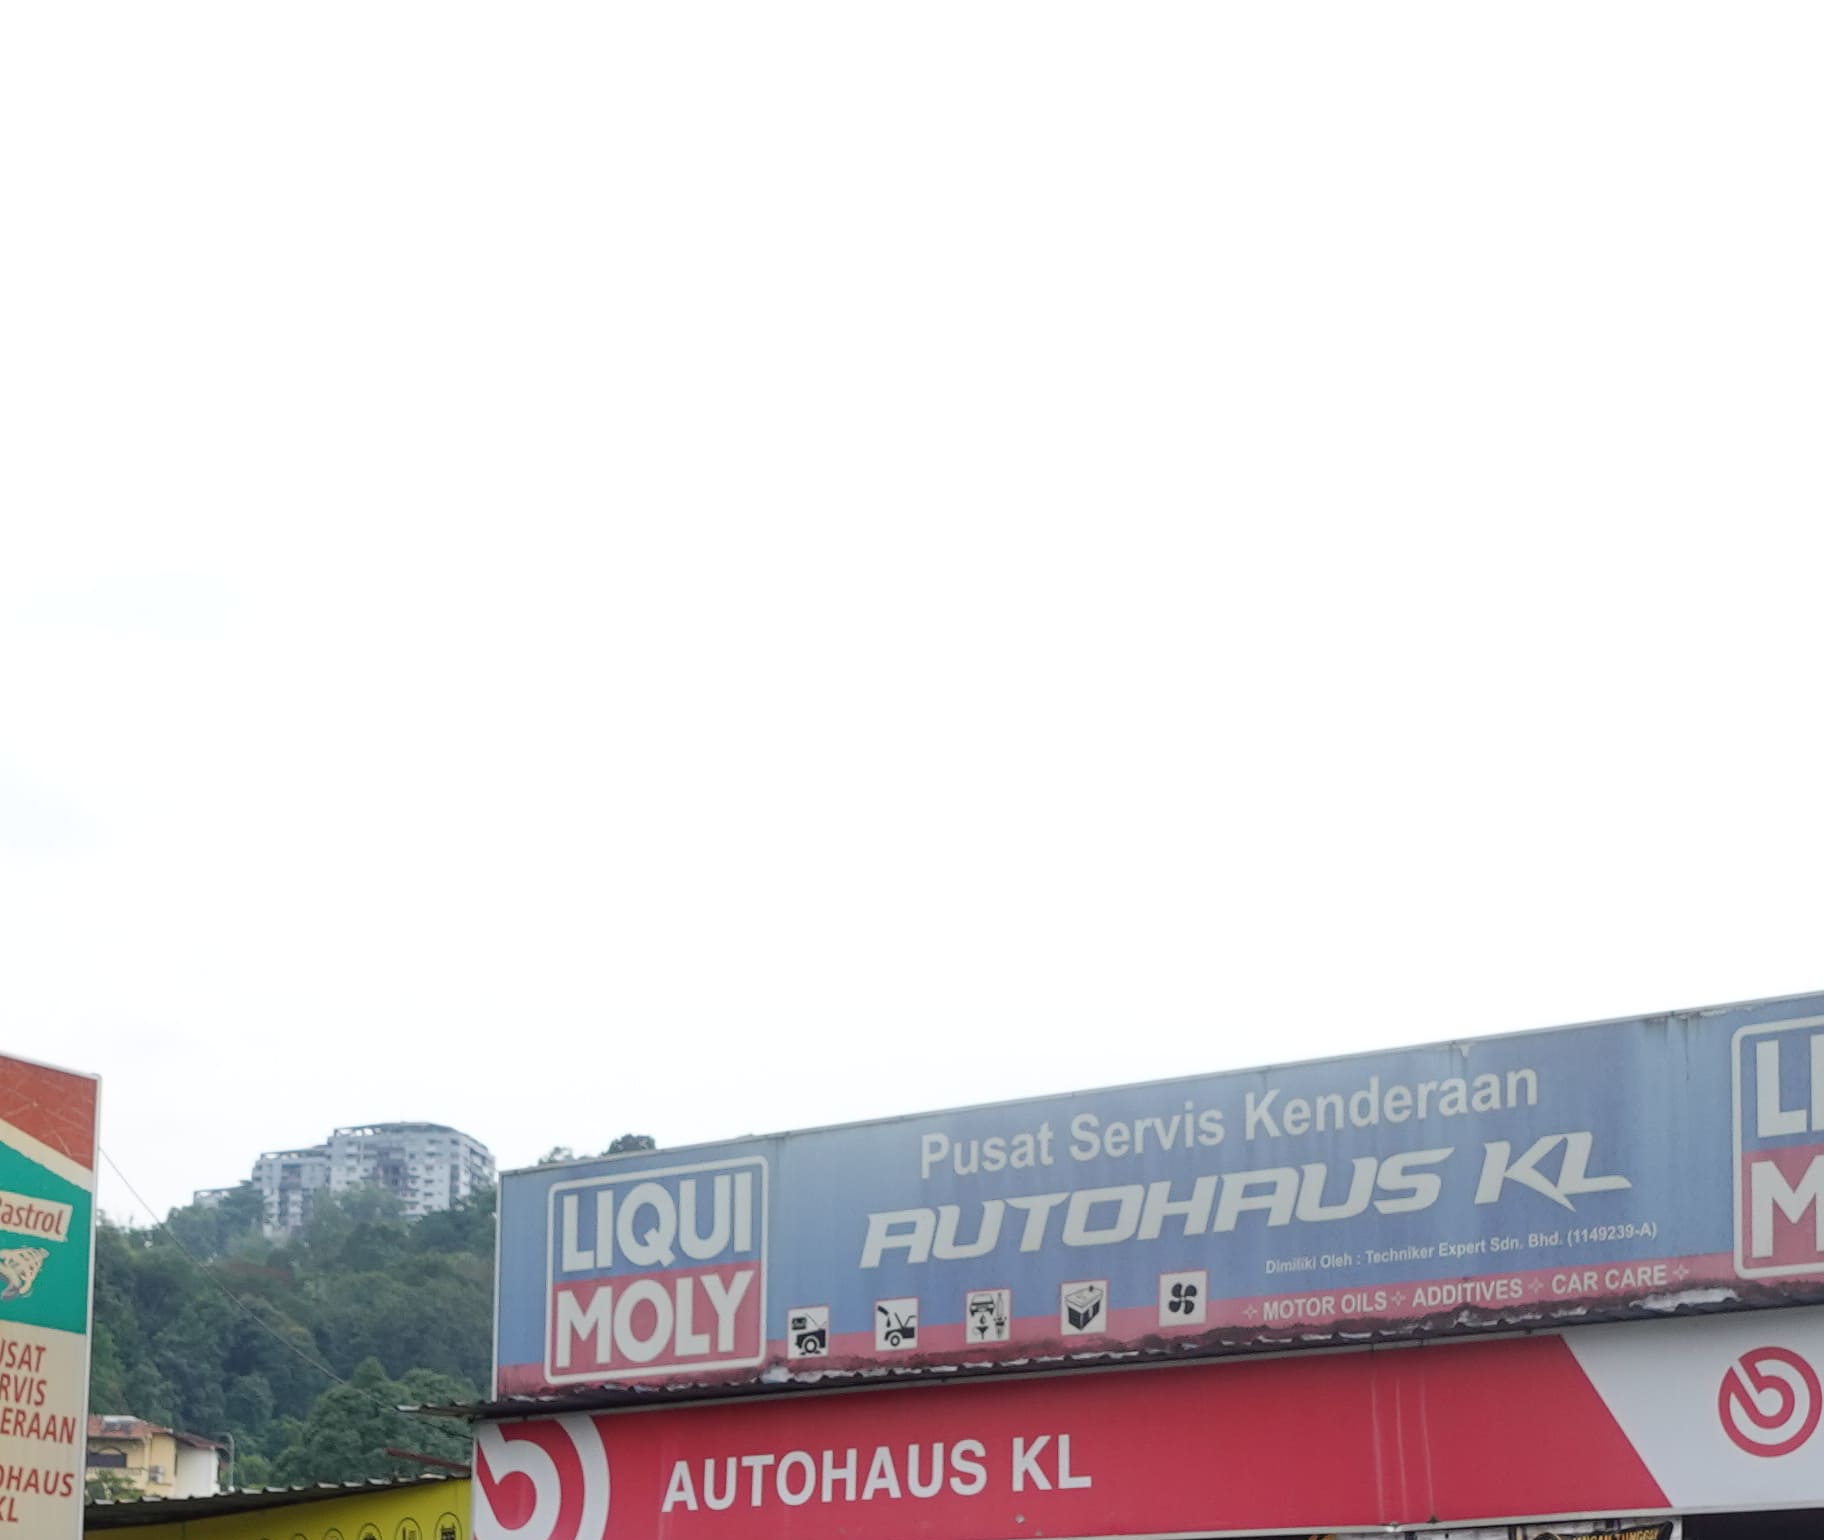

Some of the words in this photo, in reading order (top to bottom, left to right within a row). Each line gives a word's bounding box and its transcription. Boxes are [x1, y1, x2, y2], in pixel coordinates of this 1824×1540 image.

[920, 1123, 1053, 1180] Pusat
[1070, 1108, 1225, 1164] Servis
[1244, 1066, 1537, 1140] Kenderaan
[562, 1172, 752, 1272] LIQUI
[859, 1146, 1454, 1270] AUTOHAUS
[1474, 1131, 1633, 1212] KL
[1265, 1257, 1316, 1275] Dimiliki
[1320, 1253, 1353, 1269] Oleh
[1366, 1245, 1435, 1265] Techniker
[1439, 1239, 1486, 1258] Expert
[1490, 1236, 1524, 1252] Sdn.
[1528, 1231, 1564, 1249] Bhd.
[1567, 1221, 1658, 1248] (1149239-A)
[556, 1270, 755, 1369] MOLY
[1263, 1296, 1336, 1321] MOTOR
[1341, 1291, 1387, 1314] OILS
[1412, 1278, 1523, 1309] ADDITIVES
[1552, 1271, 1598, 1295] CAR
[1605, 1264, 1668, 1290] CARE
[662, 1439, 987, 1513] AUTOHAUS
[1011, 1433, 1093, 1492] KL
